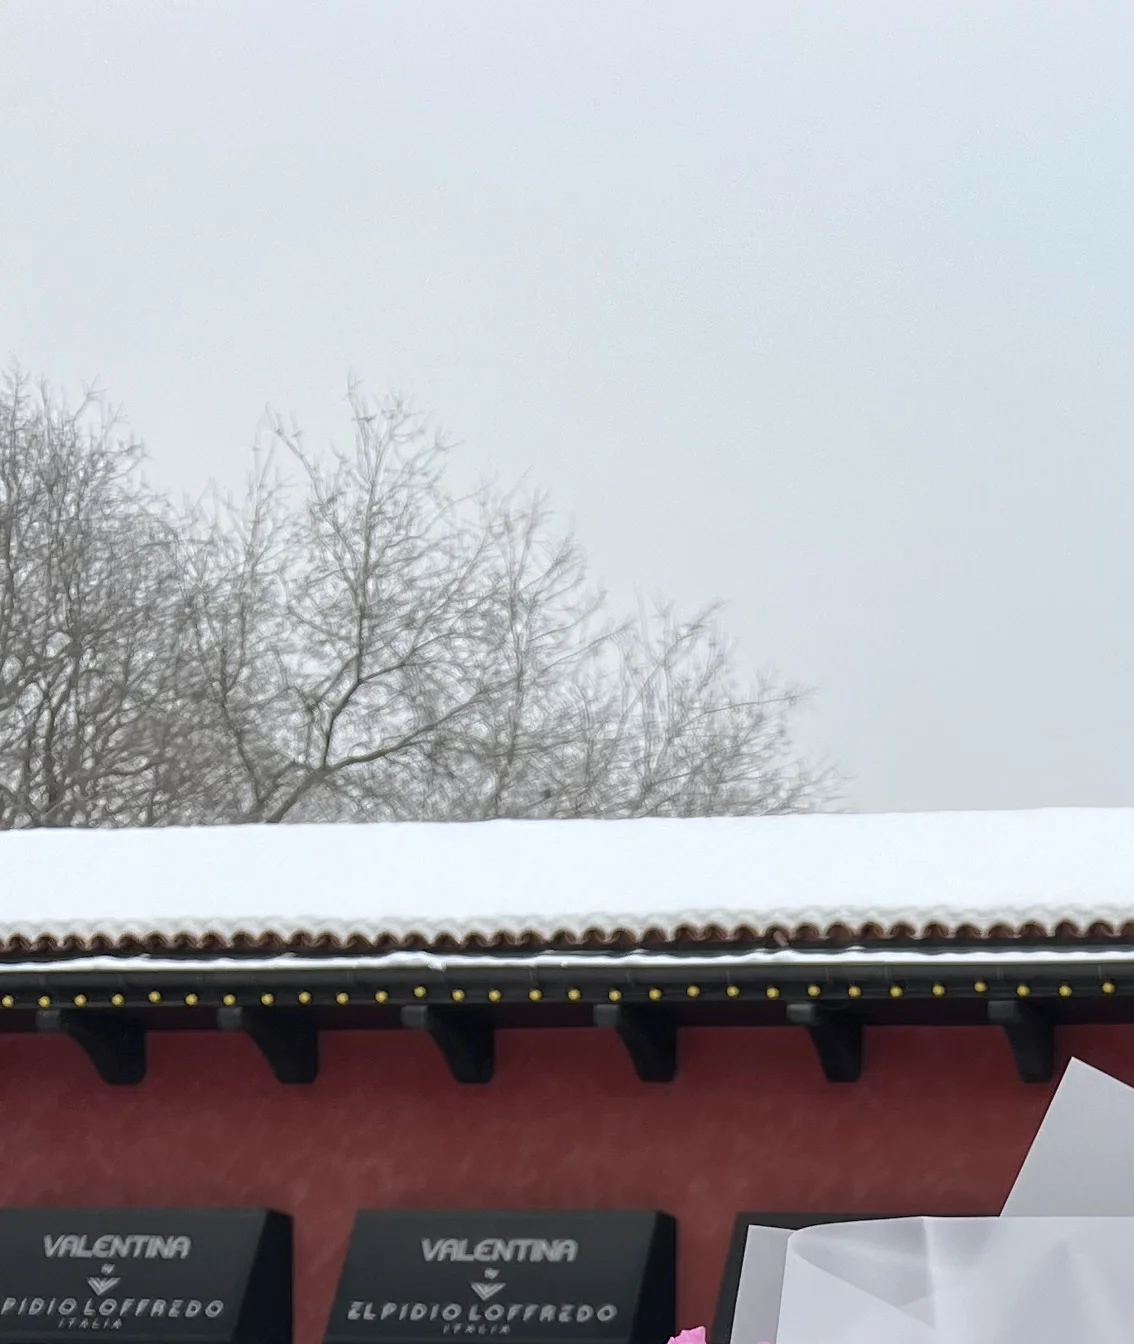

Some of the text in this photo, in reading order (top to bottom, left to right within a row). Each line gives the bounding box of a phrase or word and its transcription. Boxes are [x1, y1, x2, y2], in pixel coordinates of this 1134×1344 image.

[44, 1234, 192, 1259] VALENTINA
[420, 1237, 579, 1262] VALENTINA
[84, 1298, 225, 1318] LOFFREDO
[469, 1304, 618, 1322] LOFFREDO
[58, 1317, 123, 1330] ITALIA
[442, 1324, 512, 1335] ITALIA
